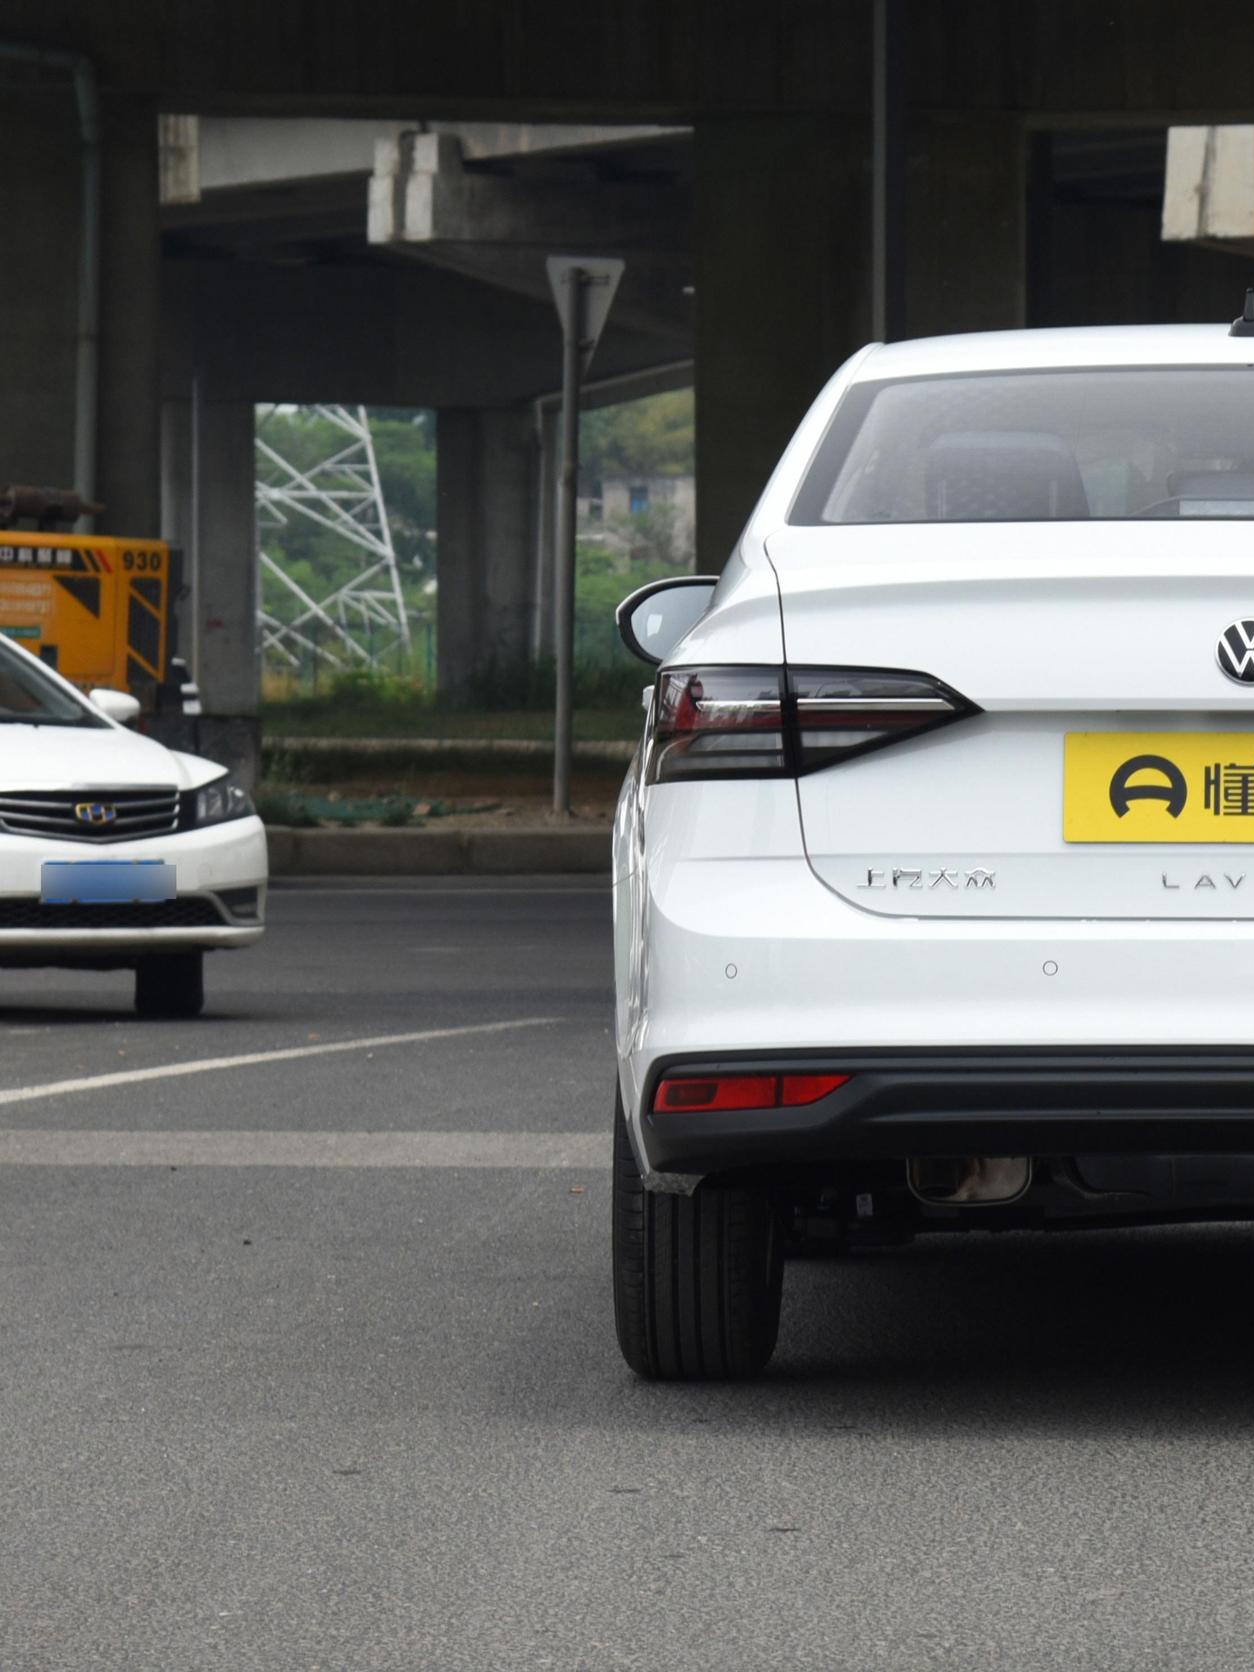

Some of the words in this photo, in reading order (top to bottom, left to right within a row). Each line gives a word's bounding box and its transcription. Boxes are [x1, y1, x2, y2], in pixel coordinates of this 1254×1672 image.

[123, 552, 162, 572] 930
[856, 867, 997, 889] 上汽大众
